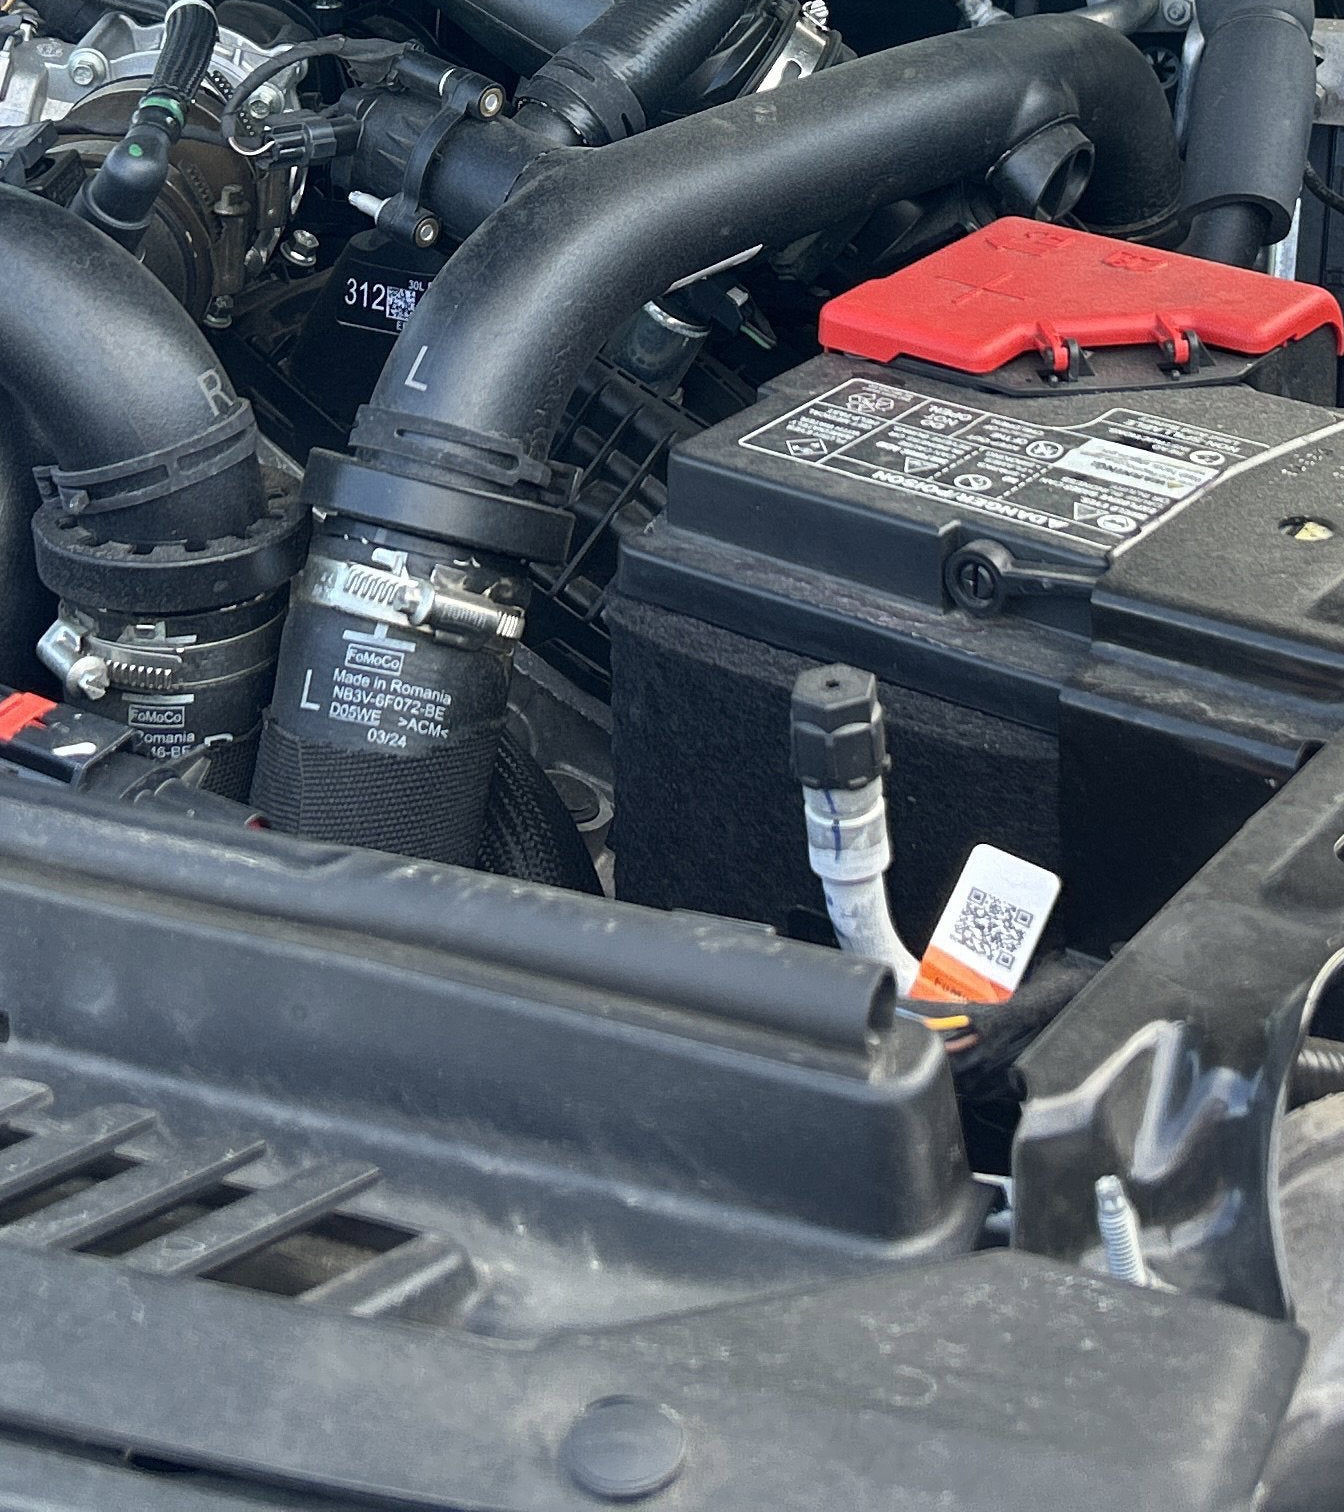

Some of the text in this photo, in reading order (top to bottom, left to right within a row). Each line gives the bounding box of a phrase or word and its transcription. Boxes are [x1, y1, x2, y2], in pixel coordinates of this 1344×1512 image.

[344, 278, 386, 311] 312
[408, 279, 425, 291] 30L
[404, 345, 428, 390] L
[871, 470, 1048, 525] DANGER/POISON
[347, 648, 402, 672] FoMoCo
[299, 668, 321, 710] L
[332, 686, 446, 720] NB3V-6F072-BE
[333, 667, 453, 707] Made in Romania
[130, 708, 183, 724] FoMoCo
[366, 726, 408, 749] 03/24
